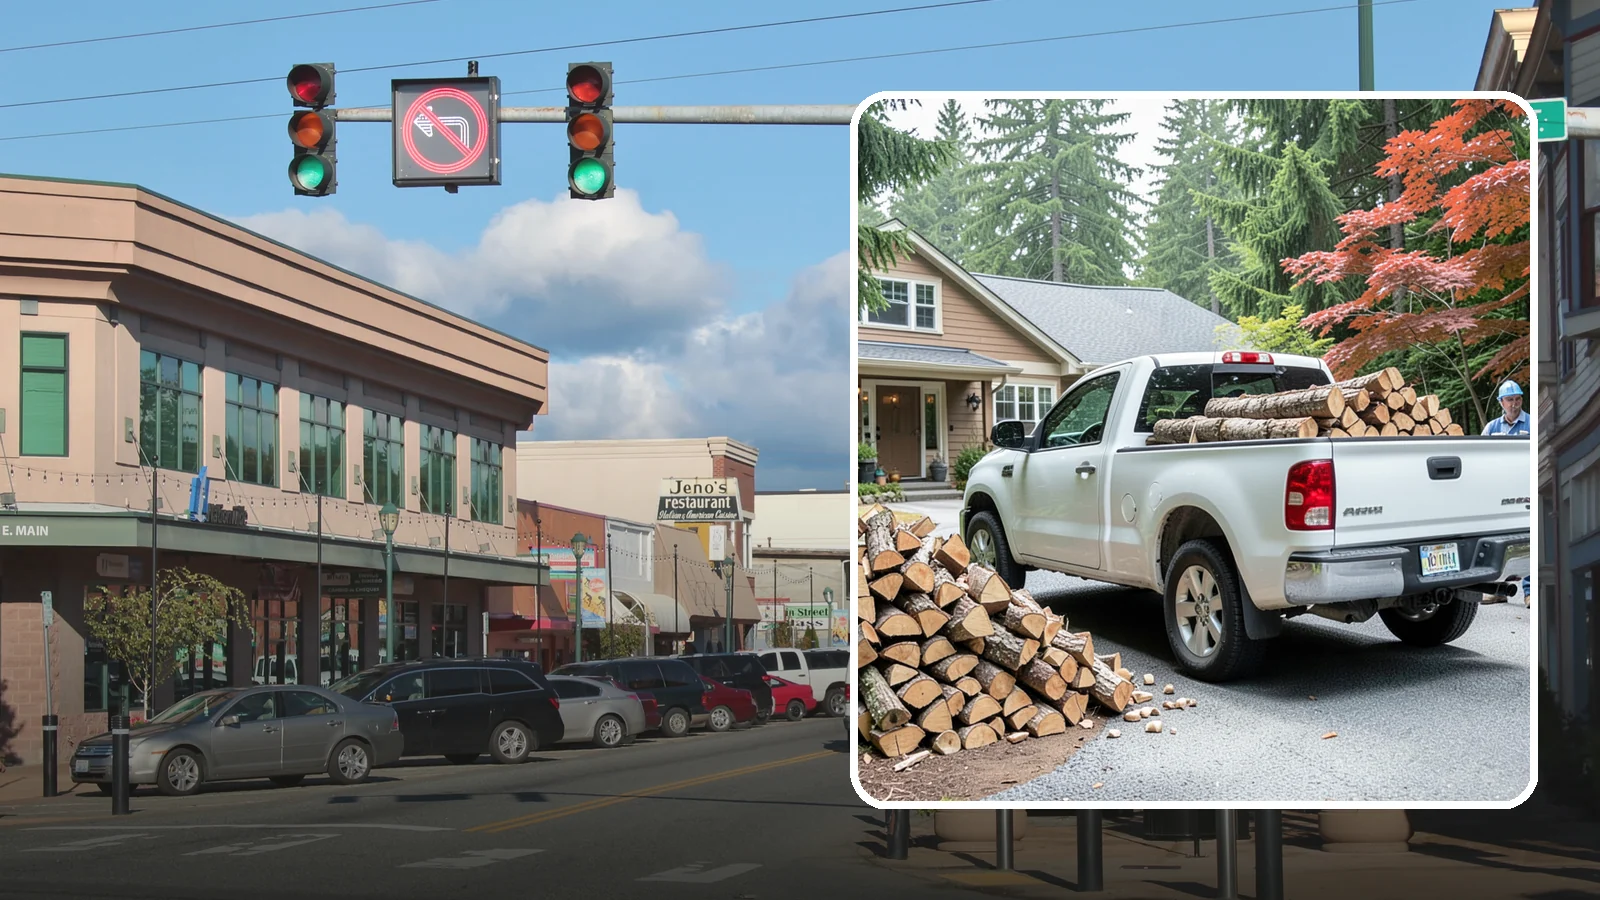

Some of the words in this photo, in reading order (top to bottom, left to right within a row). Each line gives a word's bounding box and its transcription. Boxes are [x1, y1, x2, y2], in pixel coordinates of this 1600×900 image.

[670, 480, 727, 494] Jeno's
[665, 496, 731, 509] restaurant
[686, 510, 714, 519] American
[715, 510, 737, 519] Cuisine
[2, 525, 13, 536] E.
[15, 525, 49, 536] MAIN
[797, 607, 828, 617] Street
